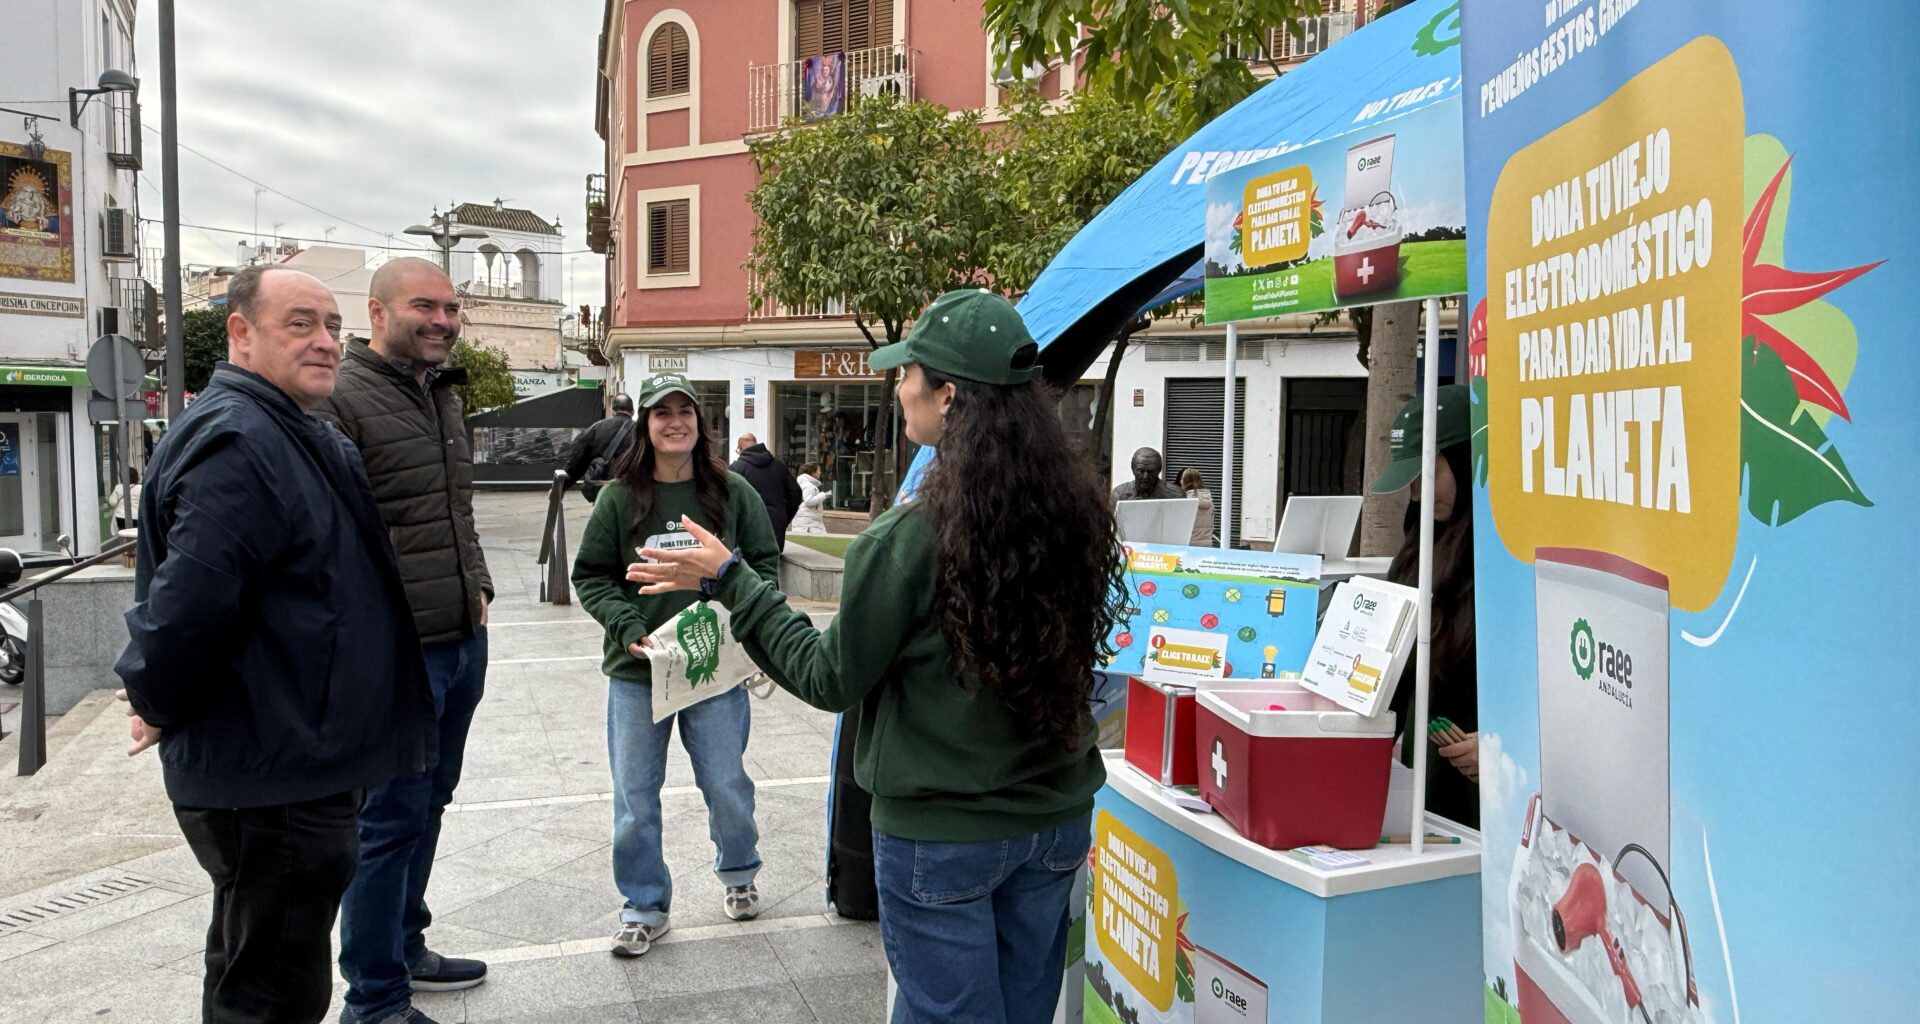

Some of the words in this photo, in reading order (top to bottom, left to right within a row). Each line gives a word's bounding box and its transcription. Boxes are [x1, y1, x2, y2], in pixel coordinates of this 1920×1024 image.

[1480, 47, 1540, 118] PEQUEÑOS
[1540, 6, 1598, 77] GESTOS,
[1351, 98, 1389, 124] NO
[1531, 176, 1584, 248] DONA
[1586, 160, 1611, 226] TU
[1612, 127, 1671, 215] VIEJO
[1251, 221, 1301, 253] PLANETA
[1505, 198, 1713, 320] ELECTRODOMÉSTICO
[0, 297, 28, 309] RISIMA
[30, 299, 80, 312] CONCEPCION
[652, 359, 662, 368] LA
[664, 359, 685, 368] MINA
[1519, 325, 1569, 382] PARA
[1570, 315, 1611, 377] DAR
[1612, 303, 1656, 371] VIDA
[1658, 296, 1692, 365] AL
[23, 374, 67, 382] IBERDROLA
[1521, 385, 1691, 514] PLANETA
[1598, 641, 1633, 690] raee
[1099, 845, 1169, 919] ELECTRODOMÉSTICO
[1108, 830, 1125, 862] DONA
[1125, 844, 1134, 868] TU
[1134, 851, 1157, 885] VIEJO
[1102, 871, 1119, 903] PARA
[1118, 887, 1132, 916] DAR
[1132, 898, 1151, 932] VIDA
[1150, 915, 1162, 940] AL
[1102, 895, 1160, 983] PLANETA
[1225, 988, 1247, 1010] raee
